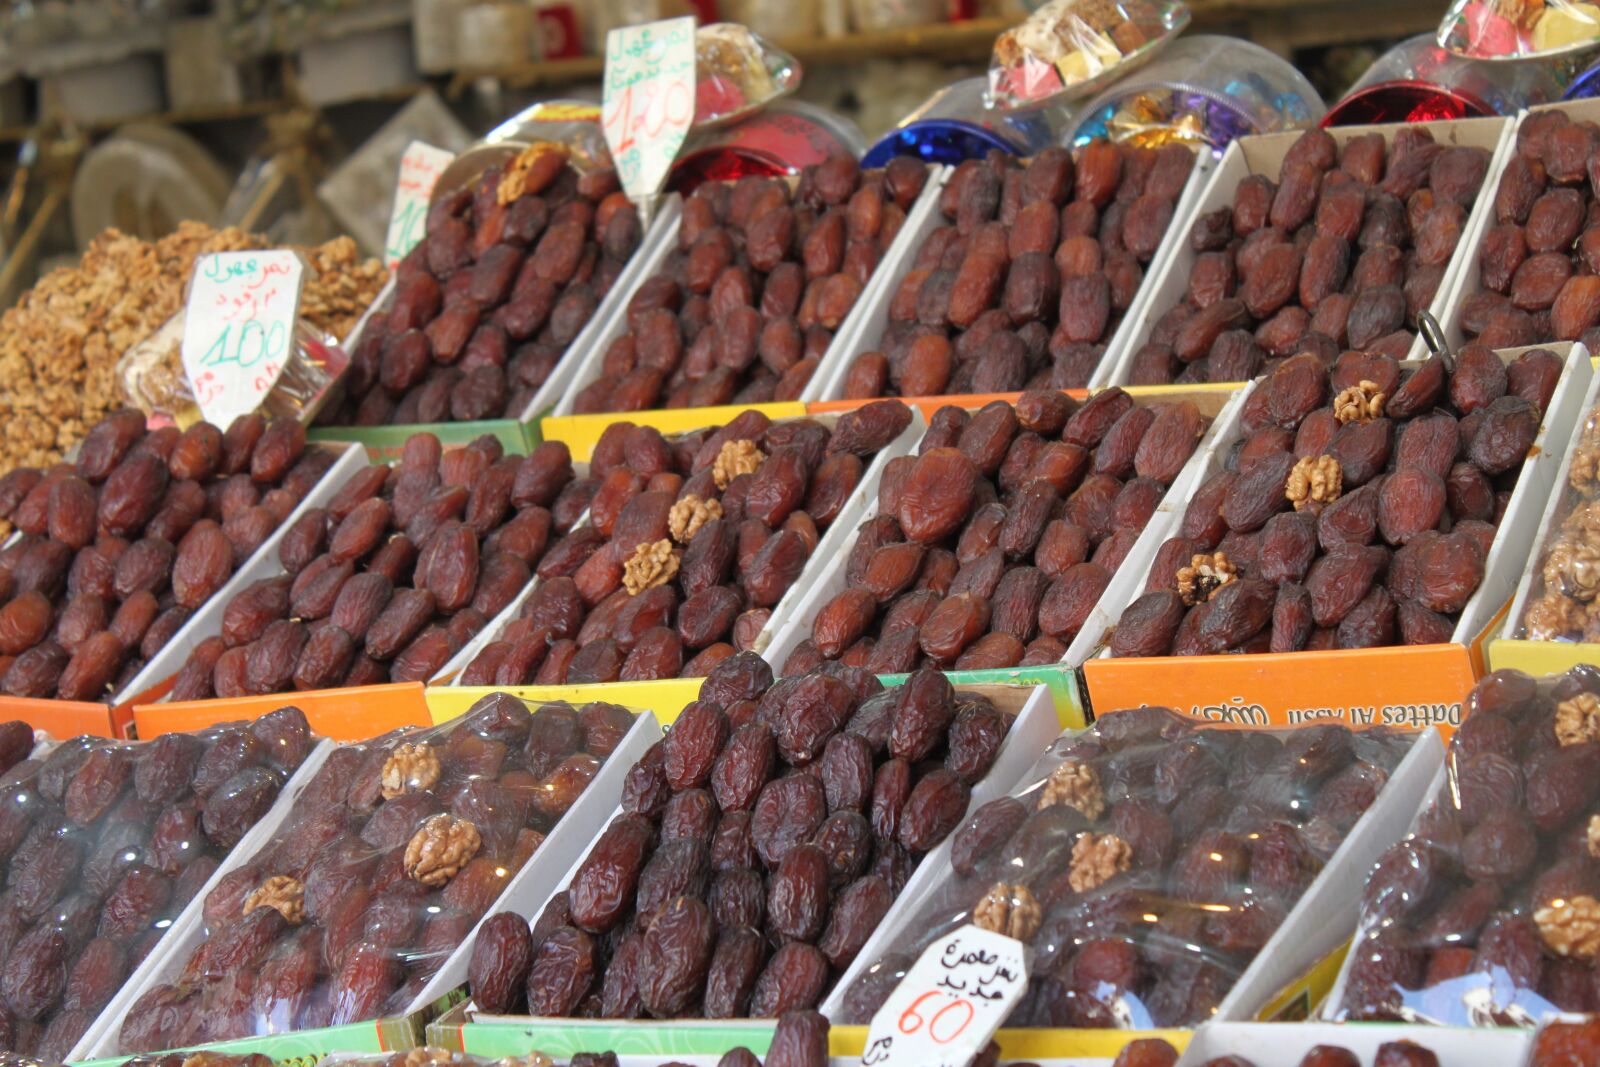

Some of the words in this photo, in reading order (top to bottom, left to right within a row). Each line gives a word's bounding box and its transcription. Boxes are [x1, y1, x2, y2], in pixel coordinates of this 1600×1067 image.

[199, 319, 286, 368] 100
[1382, 703, 1463, 727] Dattes
[897, 989, 975, 1045] 60
